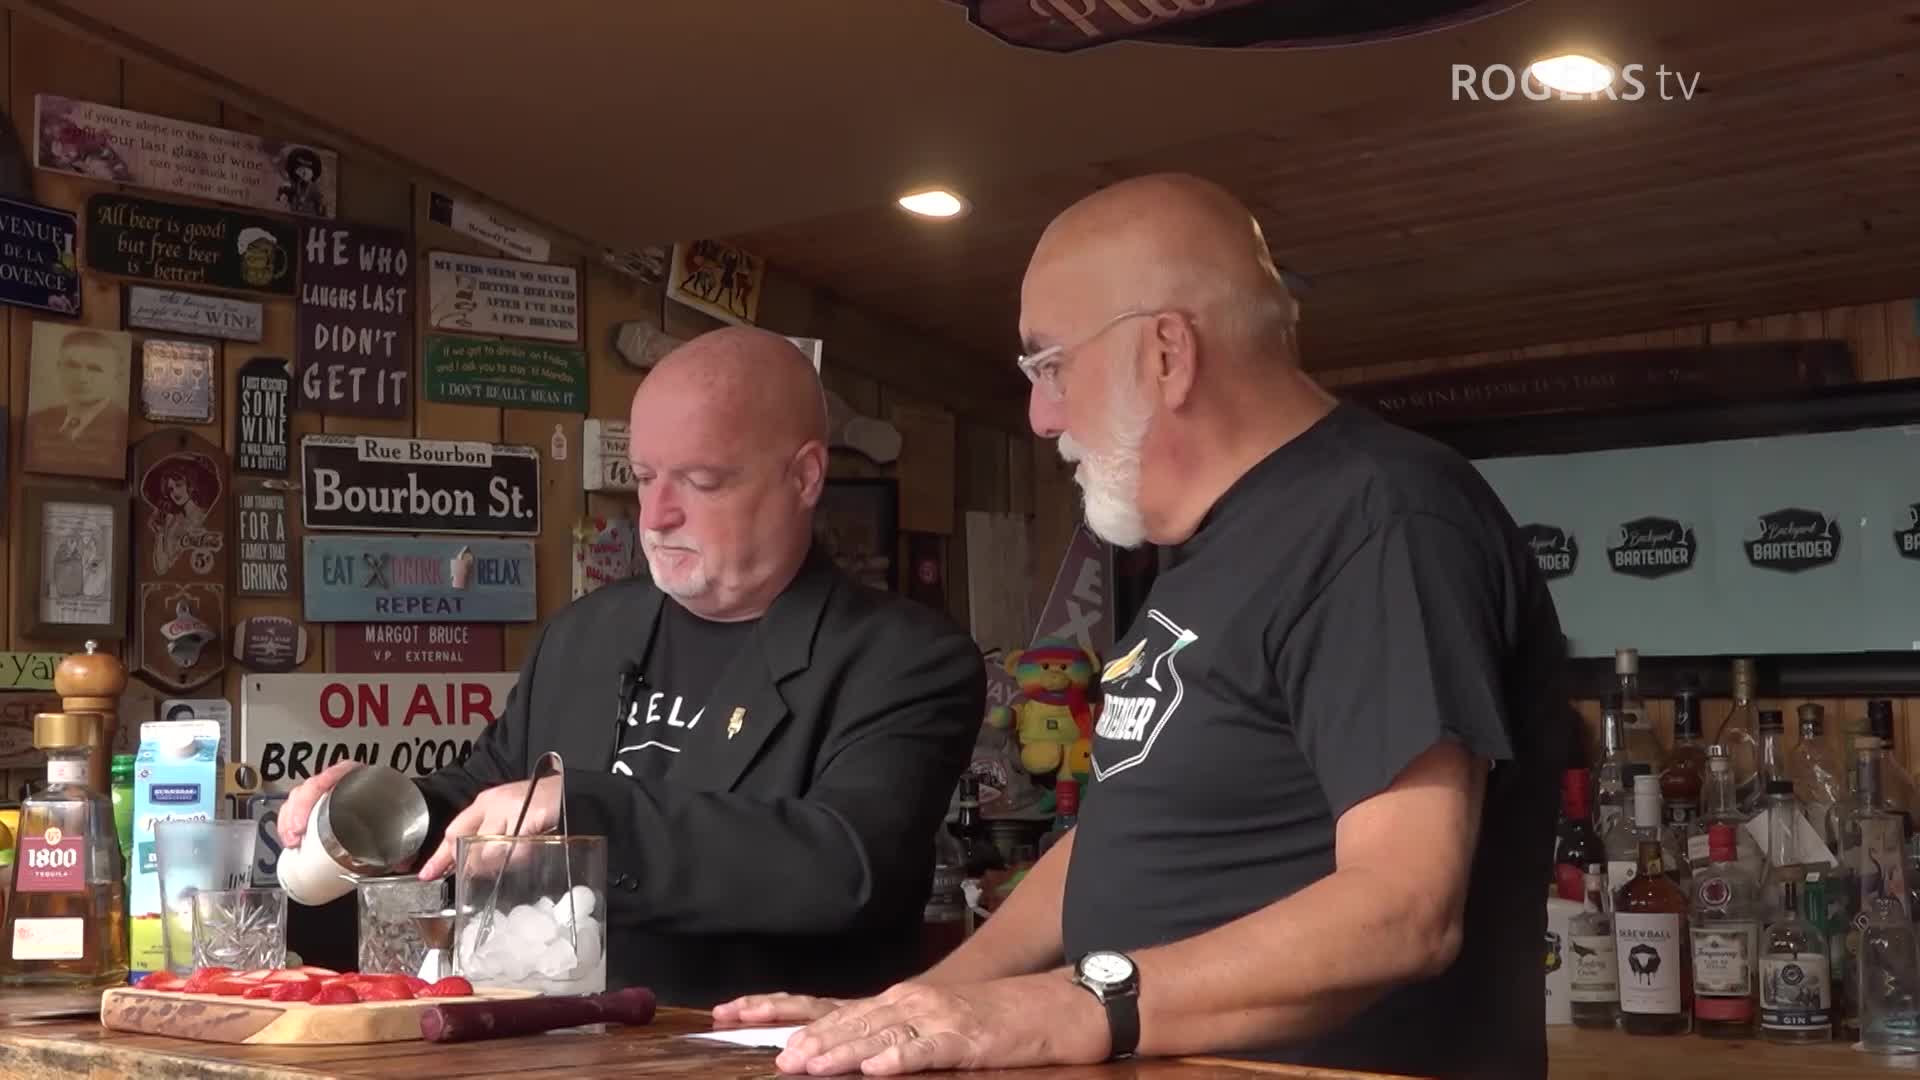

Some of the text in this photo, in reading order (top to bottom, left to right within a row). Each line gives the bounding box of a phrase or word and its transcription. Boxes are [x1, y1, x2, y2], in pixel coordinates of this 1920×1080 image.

[140, 136, 167, 153] last
[172, 143, 209, 162] glass
[213, 150, 226, 164] of
[230, 155, 263, 172] wine
[98, 205, 227, 248] All beer is good!
[3, 242, 44, 264] DE LA
[117, 231, 221, 266] but free beer
[306, 226, 409, 276] HE WHO
[127, 259, 206, 282] is better!
[455, 263, 484, 274] KIDS
[303, 283, 408, 314] LAUGHS LAST
[523, 286, 575, 301] BEHAVED
[206, 310, 257, 329] WINE
[503, 313, 525, 325] FEW
[314, 322, 397, 358] DIDN'T
[303, 362, 408, 407] GET IT
[440, 383, 576, 405] I DON'T REALLY MEAN IT
[242, 390, 287, 419] SOME
[241, 416, 287, 445] WINE
[365, 439, 402, 460] Rue
[409, 442, 488, 465] Bourbon
[313, 466, 535, 519] Bourbon St.
[240, 511, 286, 541] FOR A
[1614, 547, 1690, 567] BARTENDER
[1753, 541, 1833, 563] BARTENDER
[242, 562, 288, 591] DRINKS
[322, 555, 522, 586] EAT DRINK RELAX
[376, 596, 465, 614] REPEAT
[365, 625, 470, 645] MARGOT BRUCE
[406, 650, 465, 663] EXTERNAL
[320, 683, 498, 729] ON AIR
[28, 848, 77, 868] 1800
[1784, 1016, 1807, 1026] GIN
